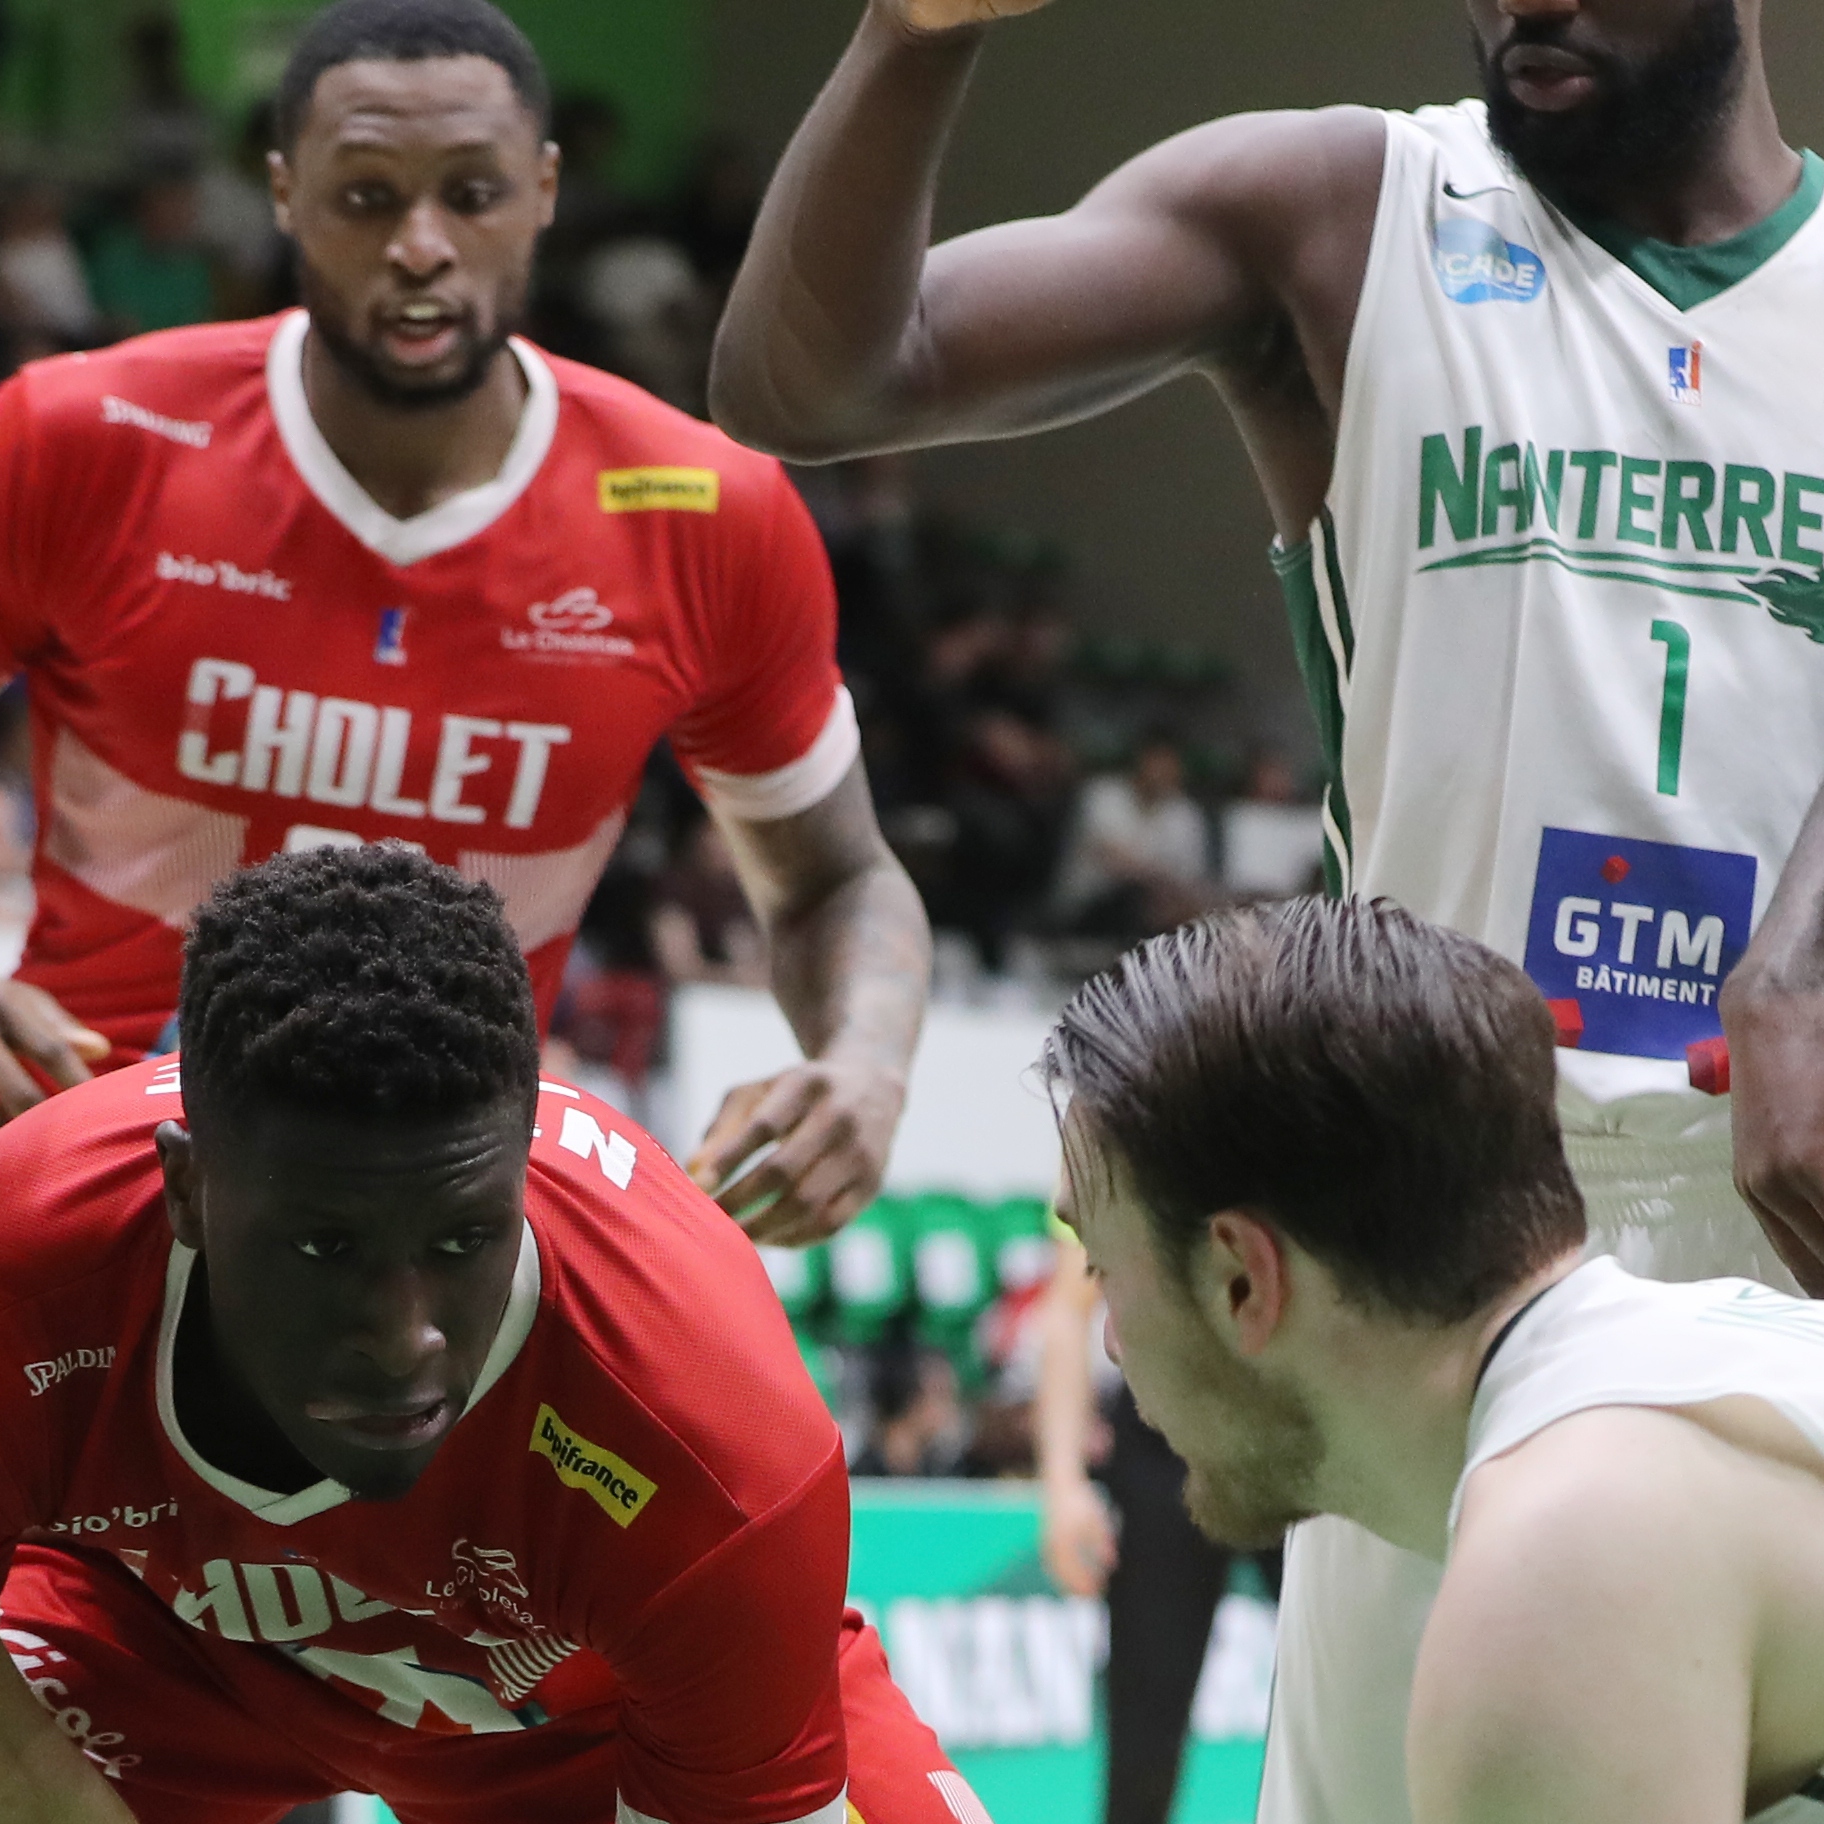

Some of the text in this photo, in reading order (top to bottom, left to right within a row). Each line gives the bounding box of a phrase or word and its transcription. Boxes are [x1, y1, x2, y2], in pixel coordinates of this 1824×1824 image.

[178, 656, 573, 831] CHOLET
[1650, 618, 1692, 797] 1
[1552, 895, 1726, 976] GTM
[1576, 964, 1717, 1007] BÂTIMENT
[540, 1415, 639, 1509] bpifrance
